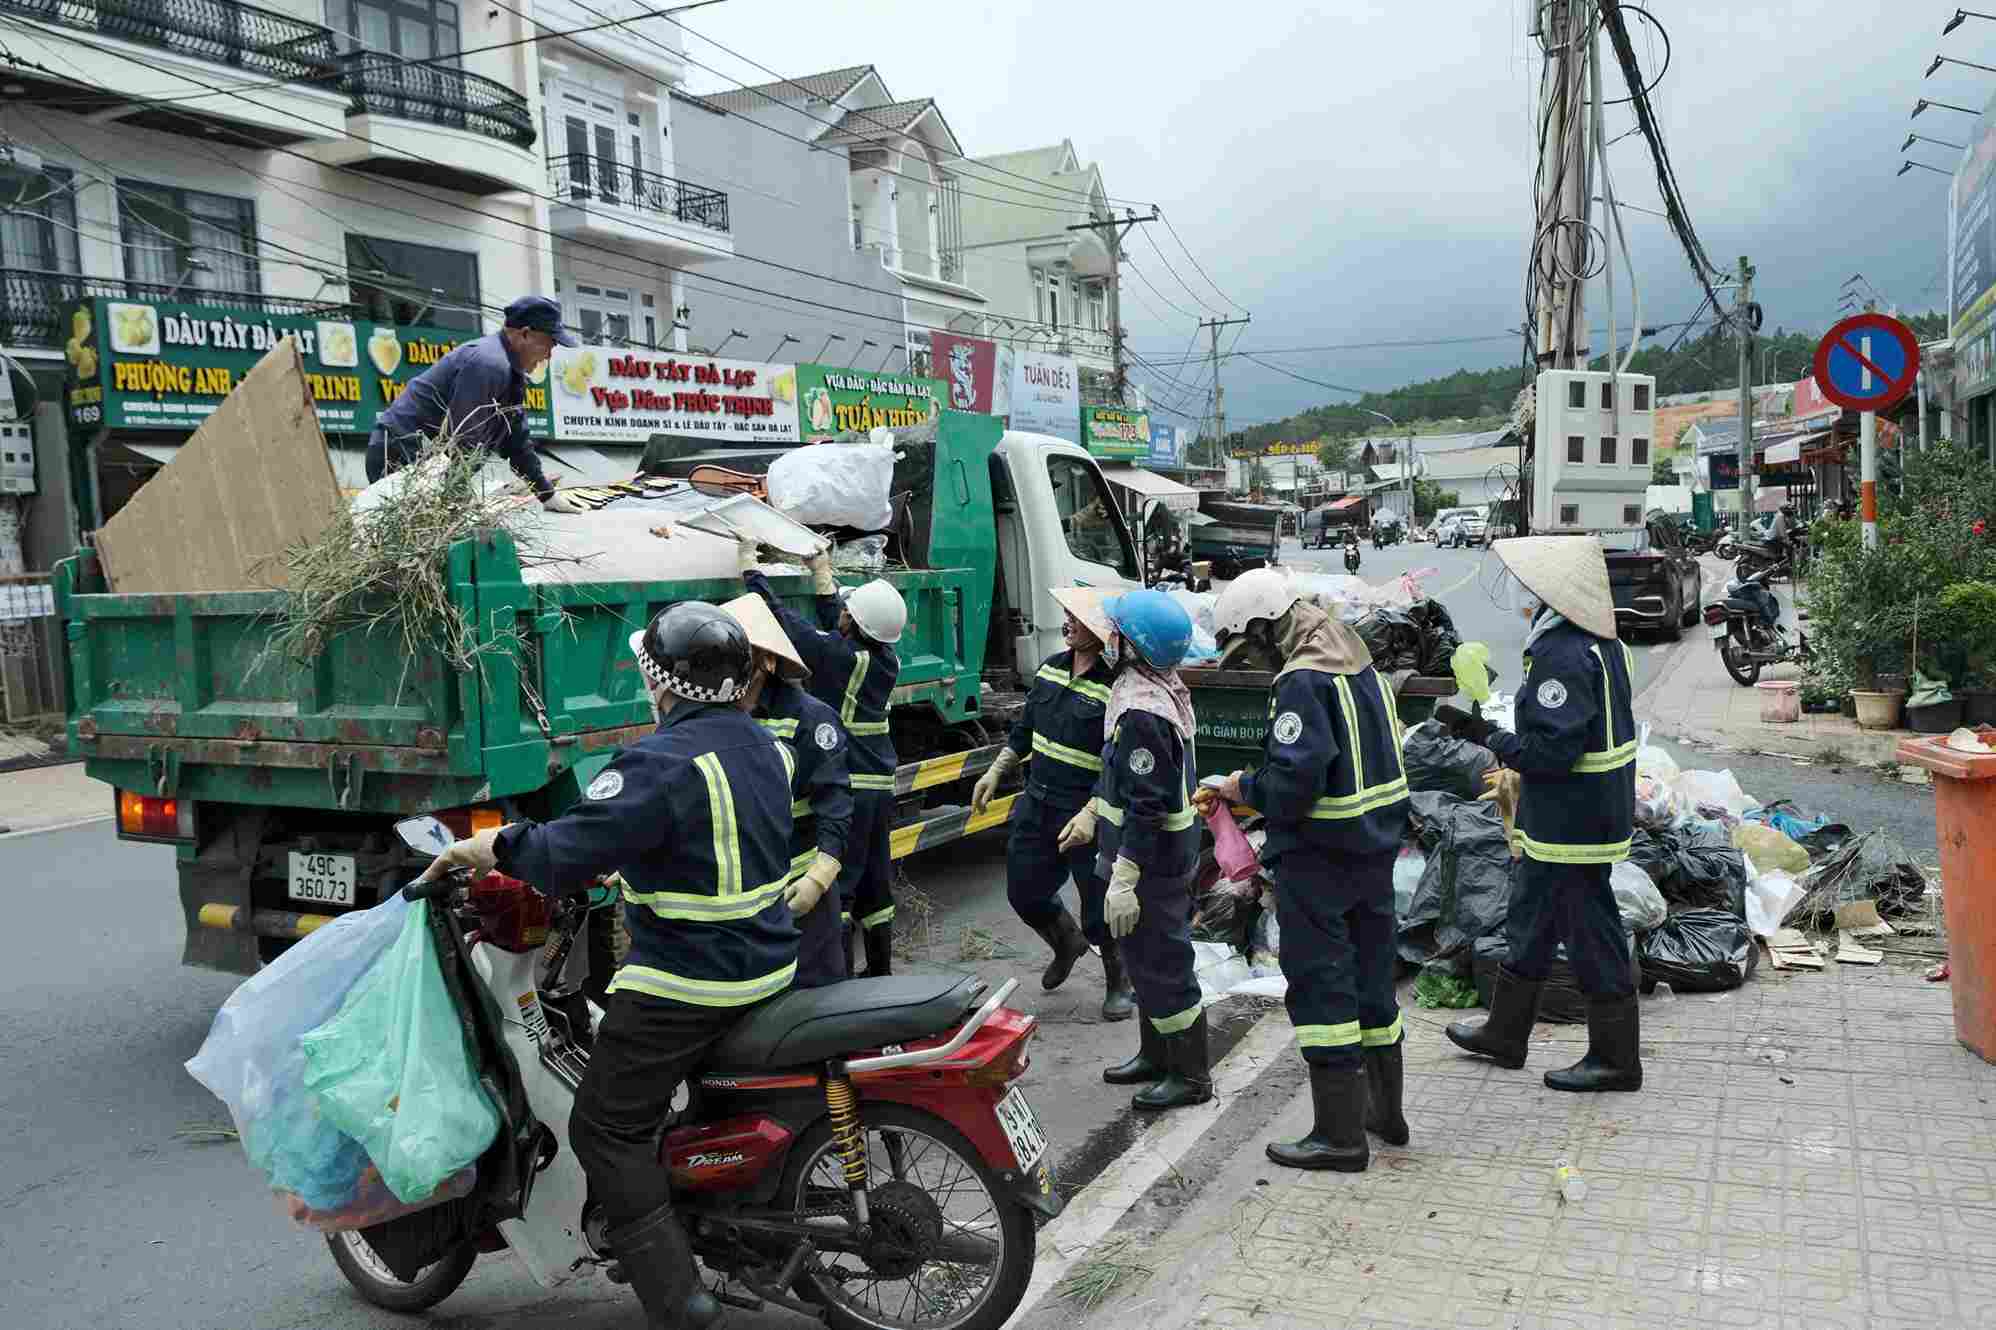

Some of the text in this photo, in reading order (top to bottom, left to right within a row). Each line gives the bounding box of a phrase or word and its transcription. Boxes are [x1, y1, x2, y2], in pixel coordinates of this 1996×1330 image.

[164, 311, 207, 346] DÂU
[209, 315, 249, 350] TÂY
[608, 354, 652, 379] DÂU
[654, 358, 692, 382] TÂY
[194, 367, 231, 395] ANH
[77, 405, 100, 423] 169
[307, 855, 336, 877] 49C
[295, 877, 348, 902] 360.73
[702, 1079, 738, 1089] HONDA
